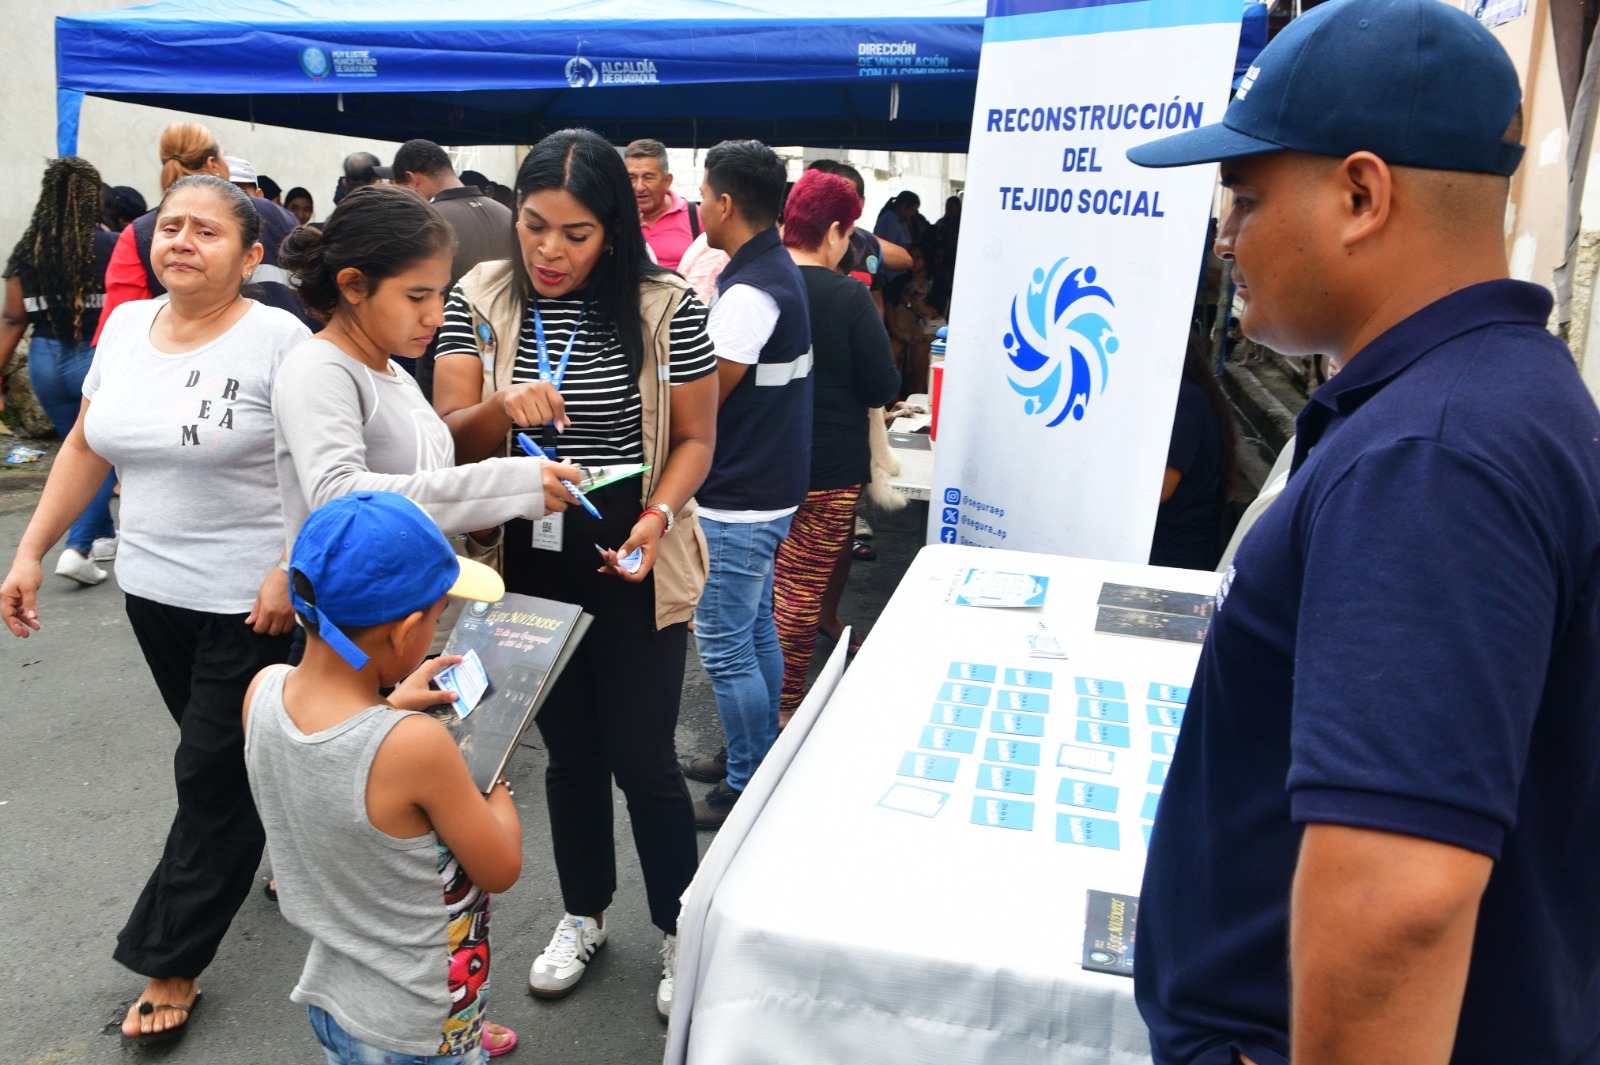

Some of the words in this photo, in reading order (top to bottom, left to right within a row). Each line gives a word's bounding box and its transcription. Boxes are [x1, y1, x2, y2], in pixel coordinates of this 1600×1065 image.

[858, 41, 917, 55] DIRECCIÓN
[601, 58, 658, 73] ALCALDÍA
[875, 54, 949, 67] VINCULACIÓN
[986, 96, 1204, 132] RECONSTRUCCIÓN
[1062, 147, 1103, 172] DEL
[999, 187, 1073, 213] TEJIDO
[1077, 188, 1165, 217] SOCIAL
